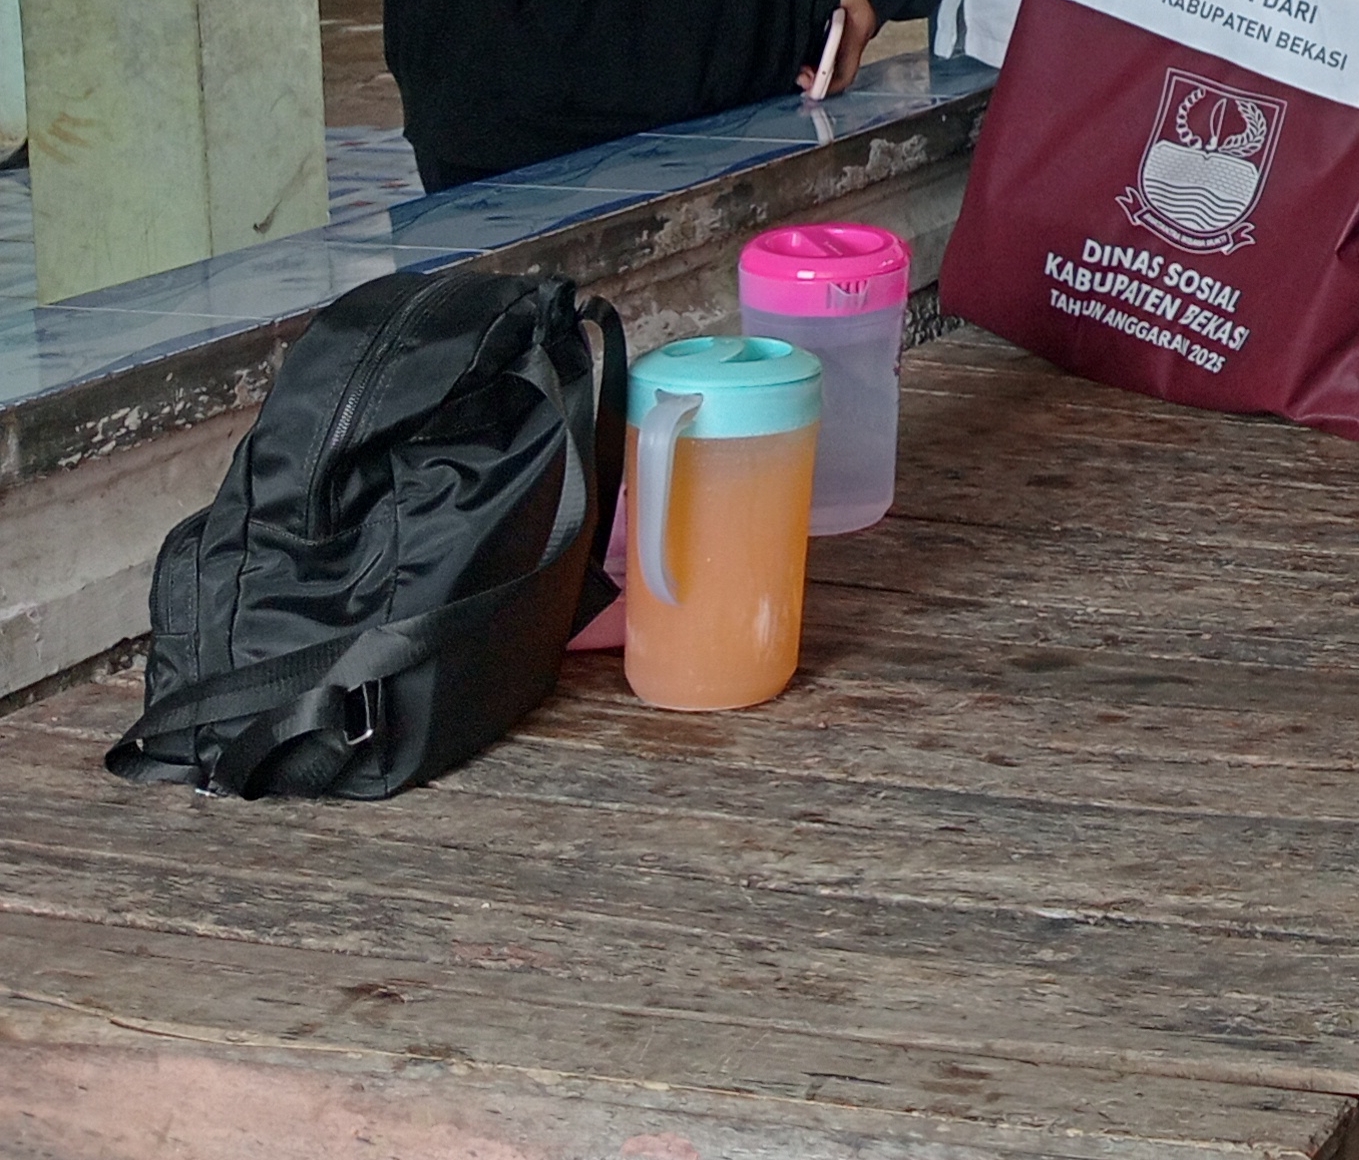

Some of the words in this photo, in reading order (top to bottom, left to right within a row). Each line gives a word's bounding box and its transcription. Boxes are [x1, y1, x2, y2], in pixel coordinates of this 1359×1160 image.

[1275, 30, 1349, 72] BEKASI
[1043, 251, 1183, 322] KABUPATEN
[1178, 303, 1250, 352] BEKASI
[1081, 238, 1165, 280] DINAS
[1162, 262, 1242, 314] SOSIAL
[1049, 288, 1107, 320] TAHUN
[1187, 343, 1226, 374] 2025
